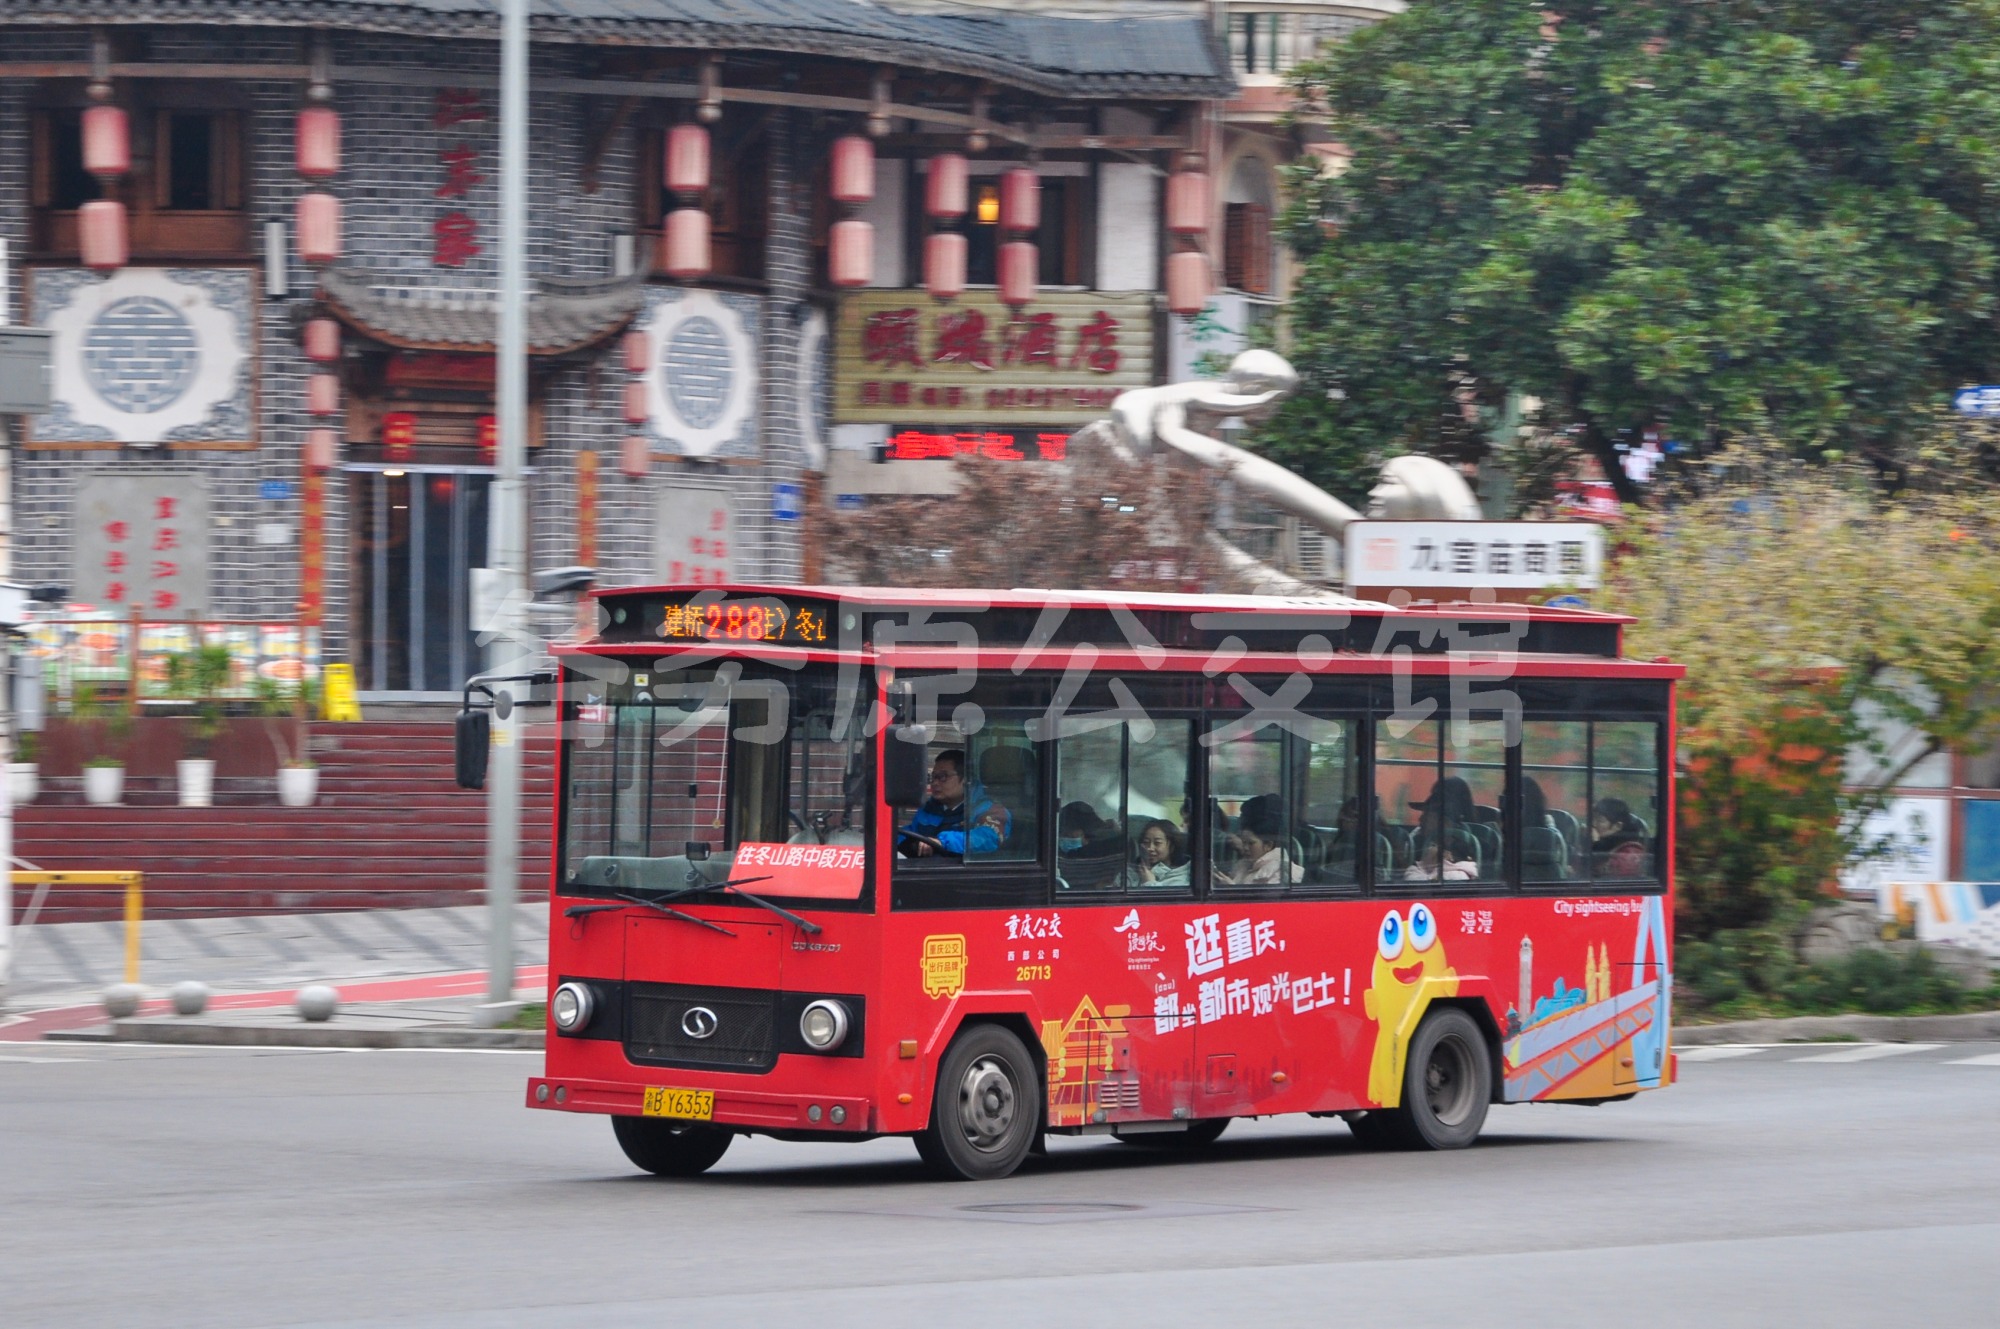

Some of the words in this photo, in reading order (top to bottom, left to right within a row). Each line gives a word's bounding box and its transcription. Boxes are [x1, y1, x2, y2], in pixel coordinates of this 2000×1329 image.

[737, 846, 865, 869] 往冬山路中段方向
[1554, 900, 1574, 917] City
[1575, 899, 1630, 916] sightseeing
[1004, 912, 1063, 940] 重庆公交
[1461, 911, 1493, 934] 漫漫
[929, 943, 959, 955] 重庆公交
[1007, 949, 1060, 961] 西部公司
[929, 961, 958, 972] 出行品牌
[1016, 965, 1051, 981] 26713
